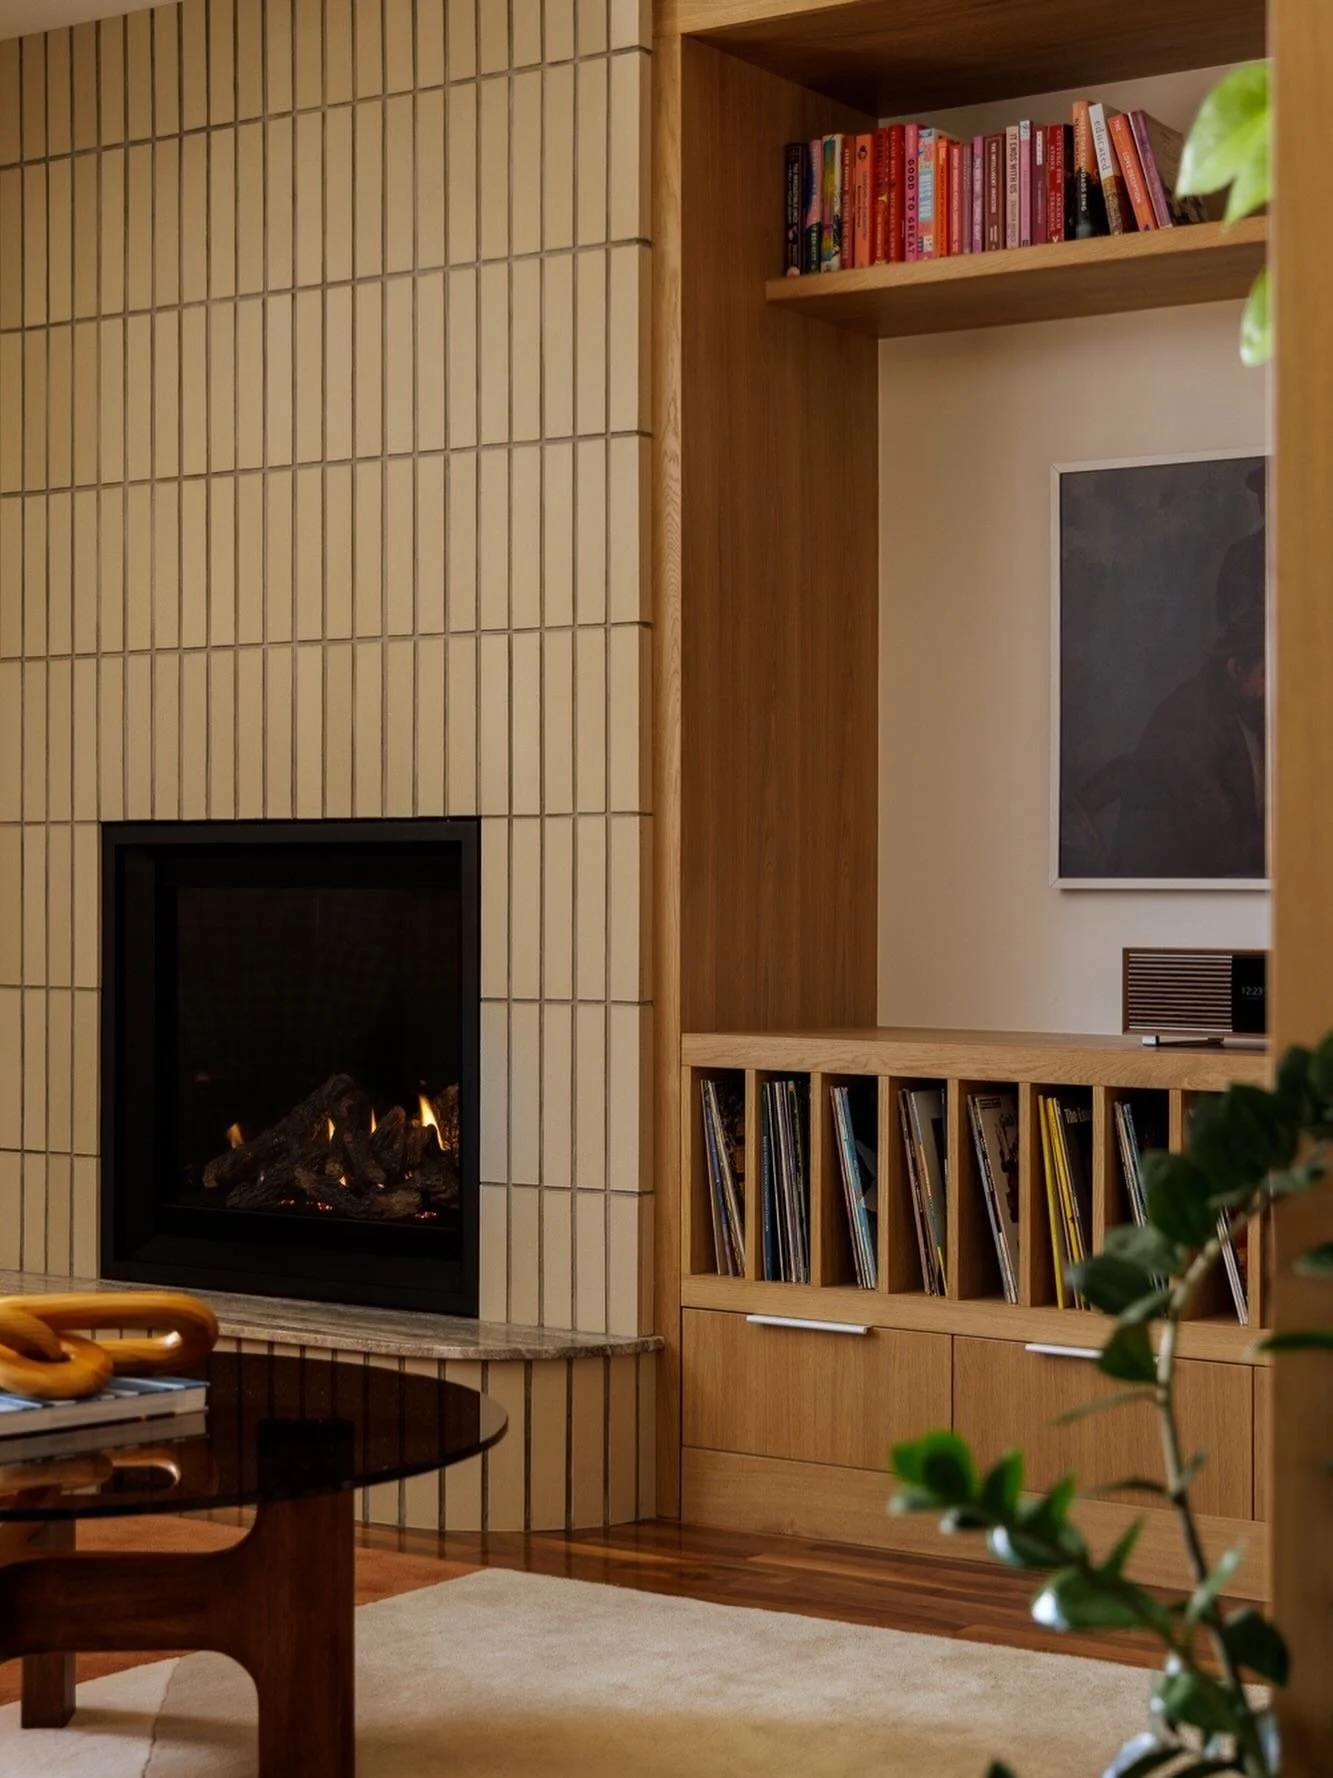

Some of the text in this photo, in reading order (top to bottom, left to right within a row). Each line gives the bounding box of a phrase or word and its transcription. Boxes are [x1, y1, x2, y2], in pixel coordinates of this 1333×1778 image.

[1095, 120, 1111, 171] educated
[1009, 133, 1017, 194] IT ENDS WITH US
[908, 195, 915, 211] TO
[1241, 986, 1263, 996] 12:23
